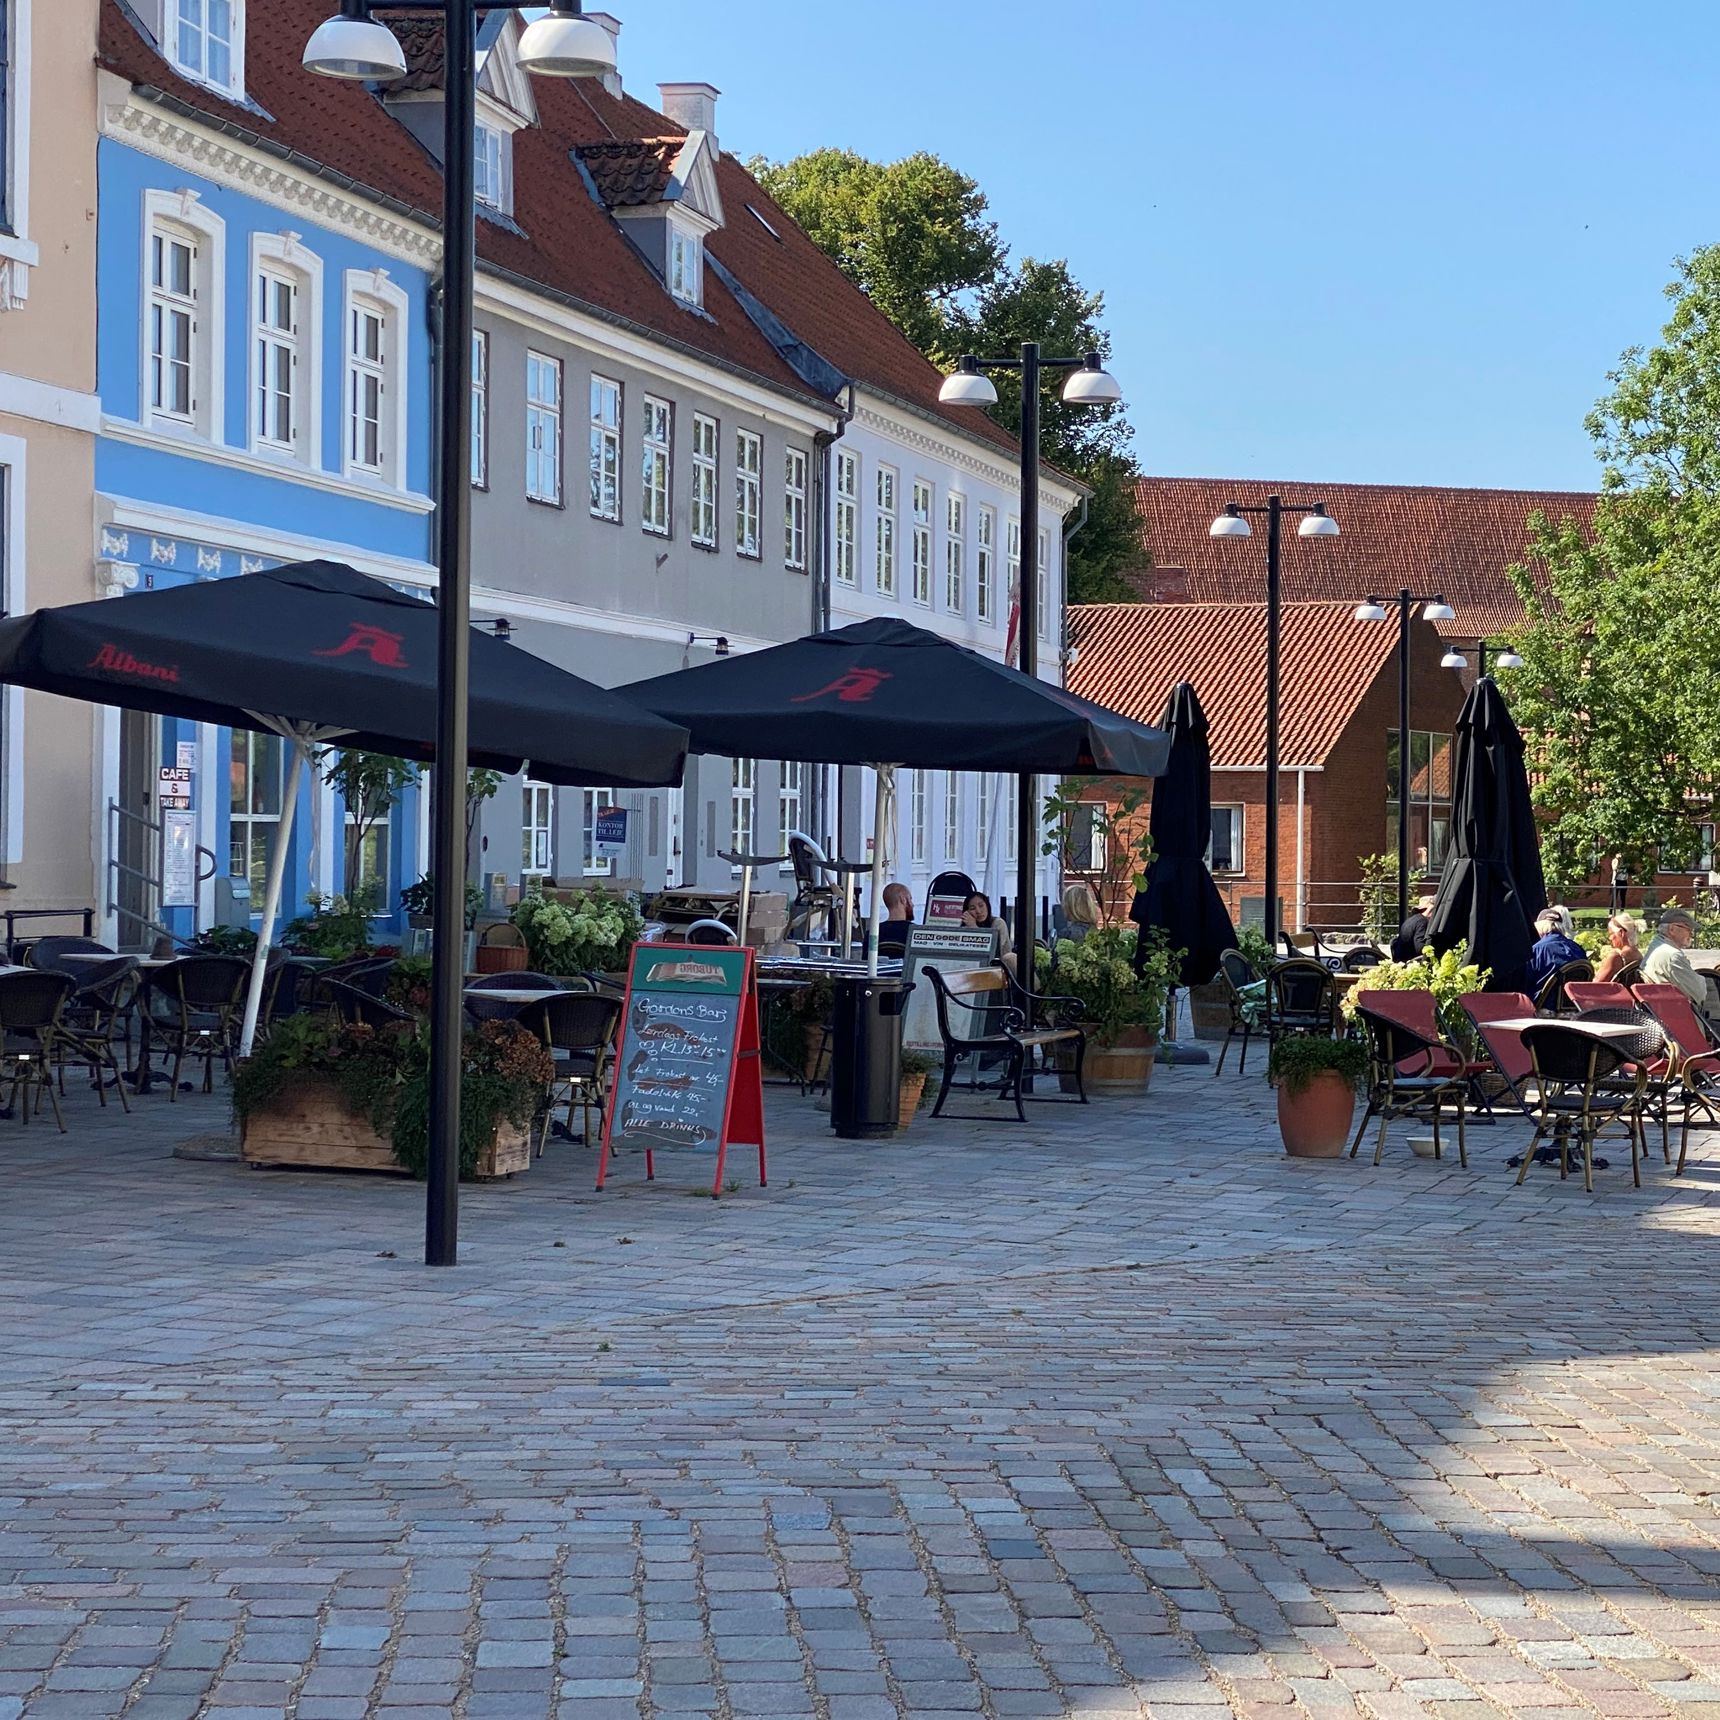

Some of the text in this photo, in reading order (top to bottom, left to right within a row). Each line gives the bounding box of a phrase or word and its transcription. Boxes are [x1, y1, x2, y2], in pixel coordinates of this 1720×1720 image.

[87, 642, 179, 682] Albani
[161, 768, 189, 780] CAFE
[171, 783, 178, 794] &
